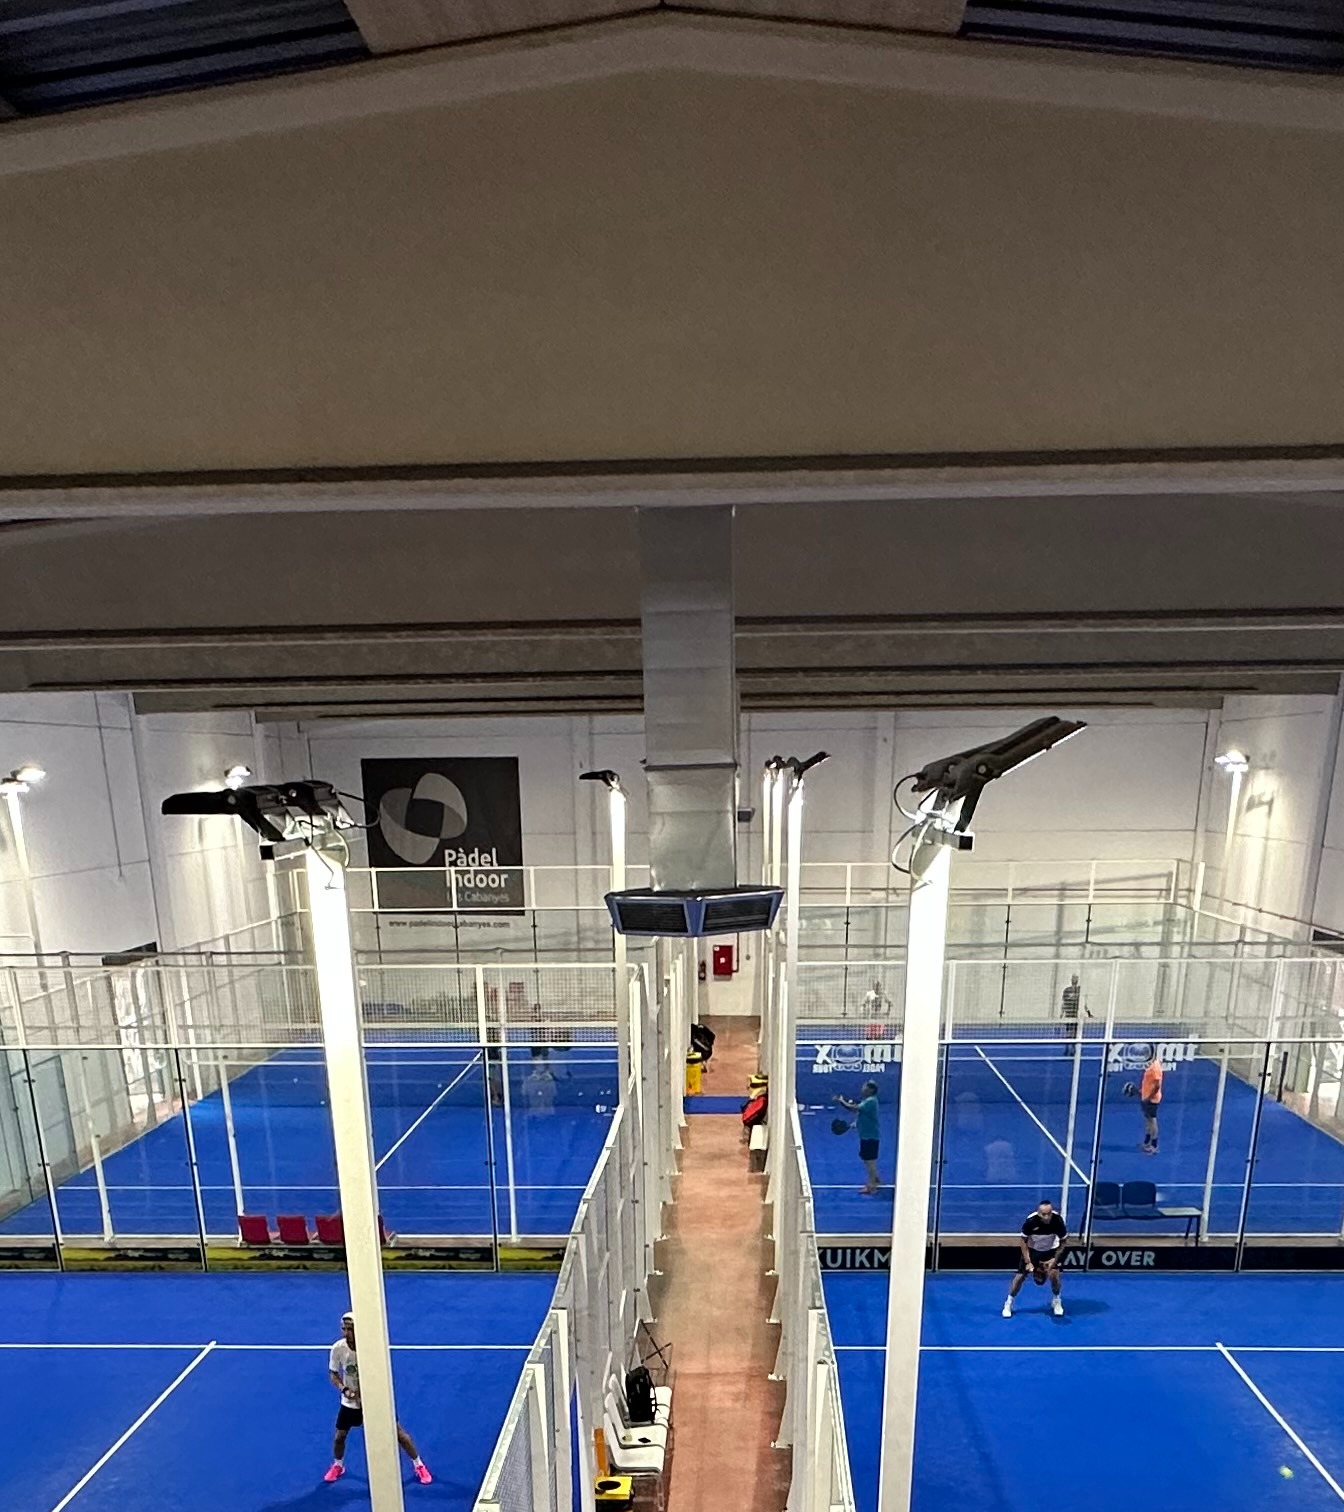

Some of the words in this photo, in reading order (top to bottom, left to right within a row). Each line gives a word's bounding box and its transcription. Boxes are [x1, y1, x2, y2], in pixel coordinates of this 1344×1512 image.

[444, 847, 498, 868] Pàdel
[818, 1248, 891, 1268] UIKM
[1102, 1250, 1156, 1266] OVER
